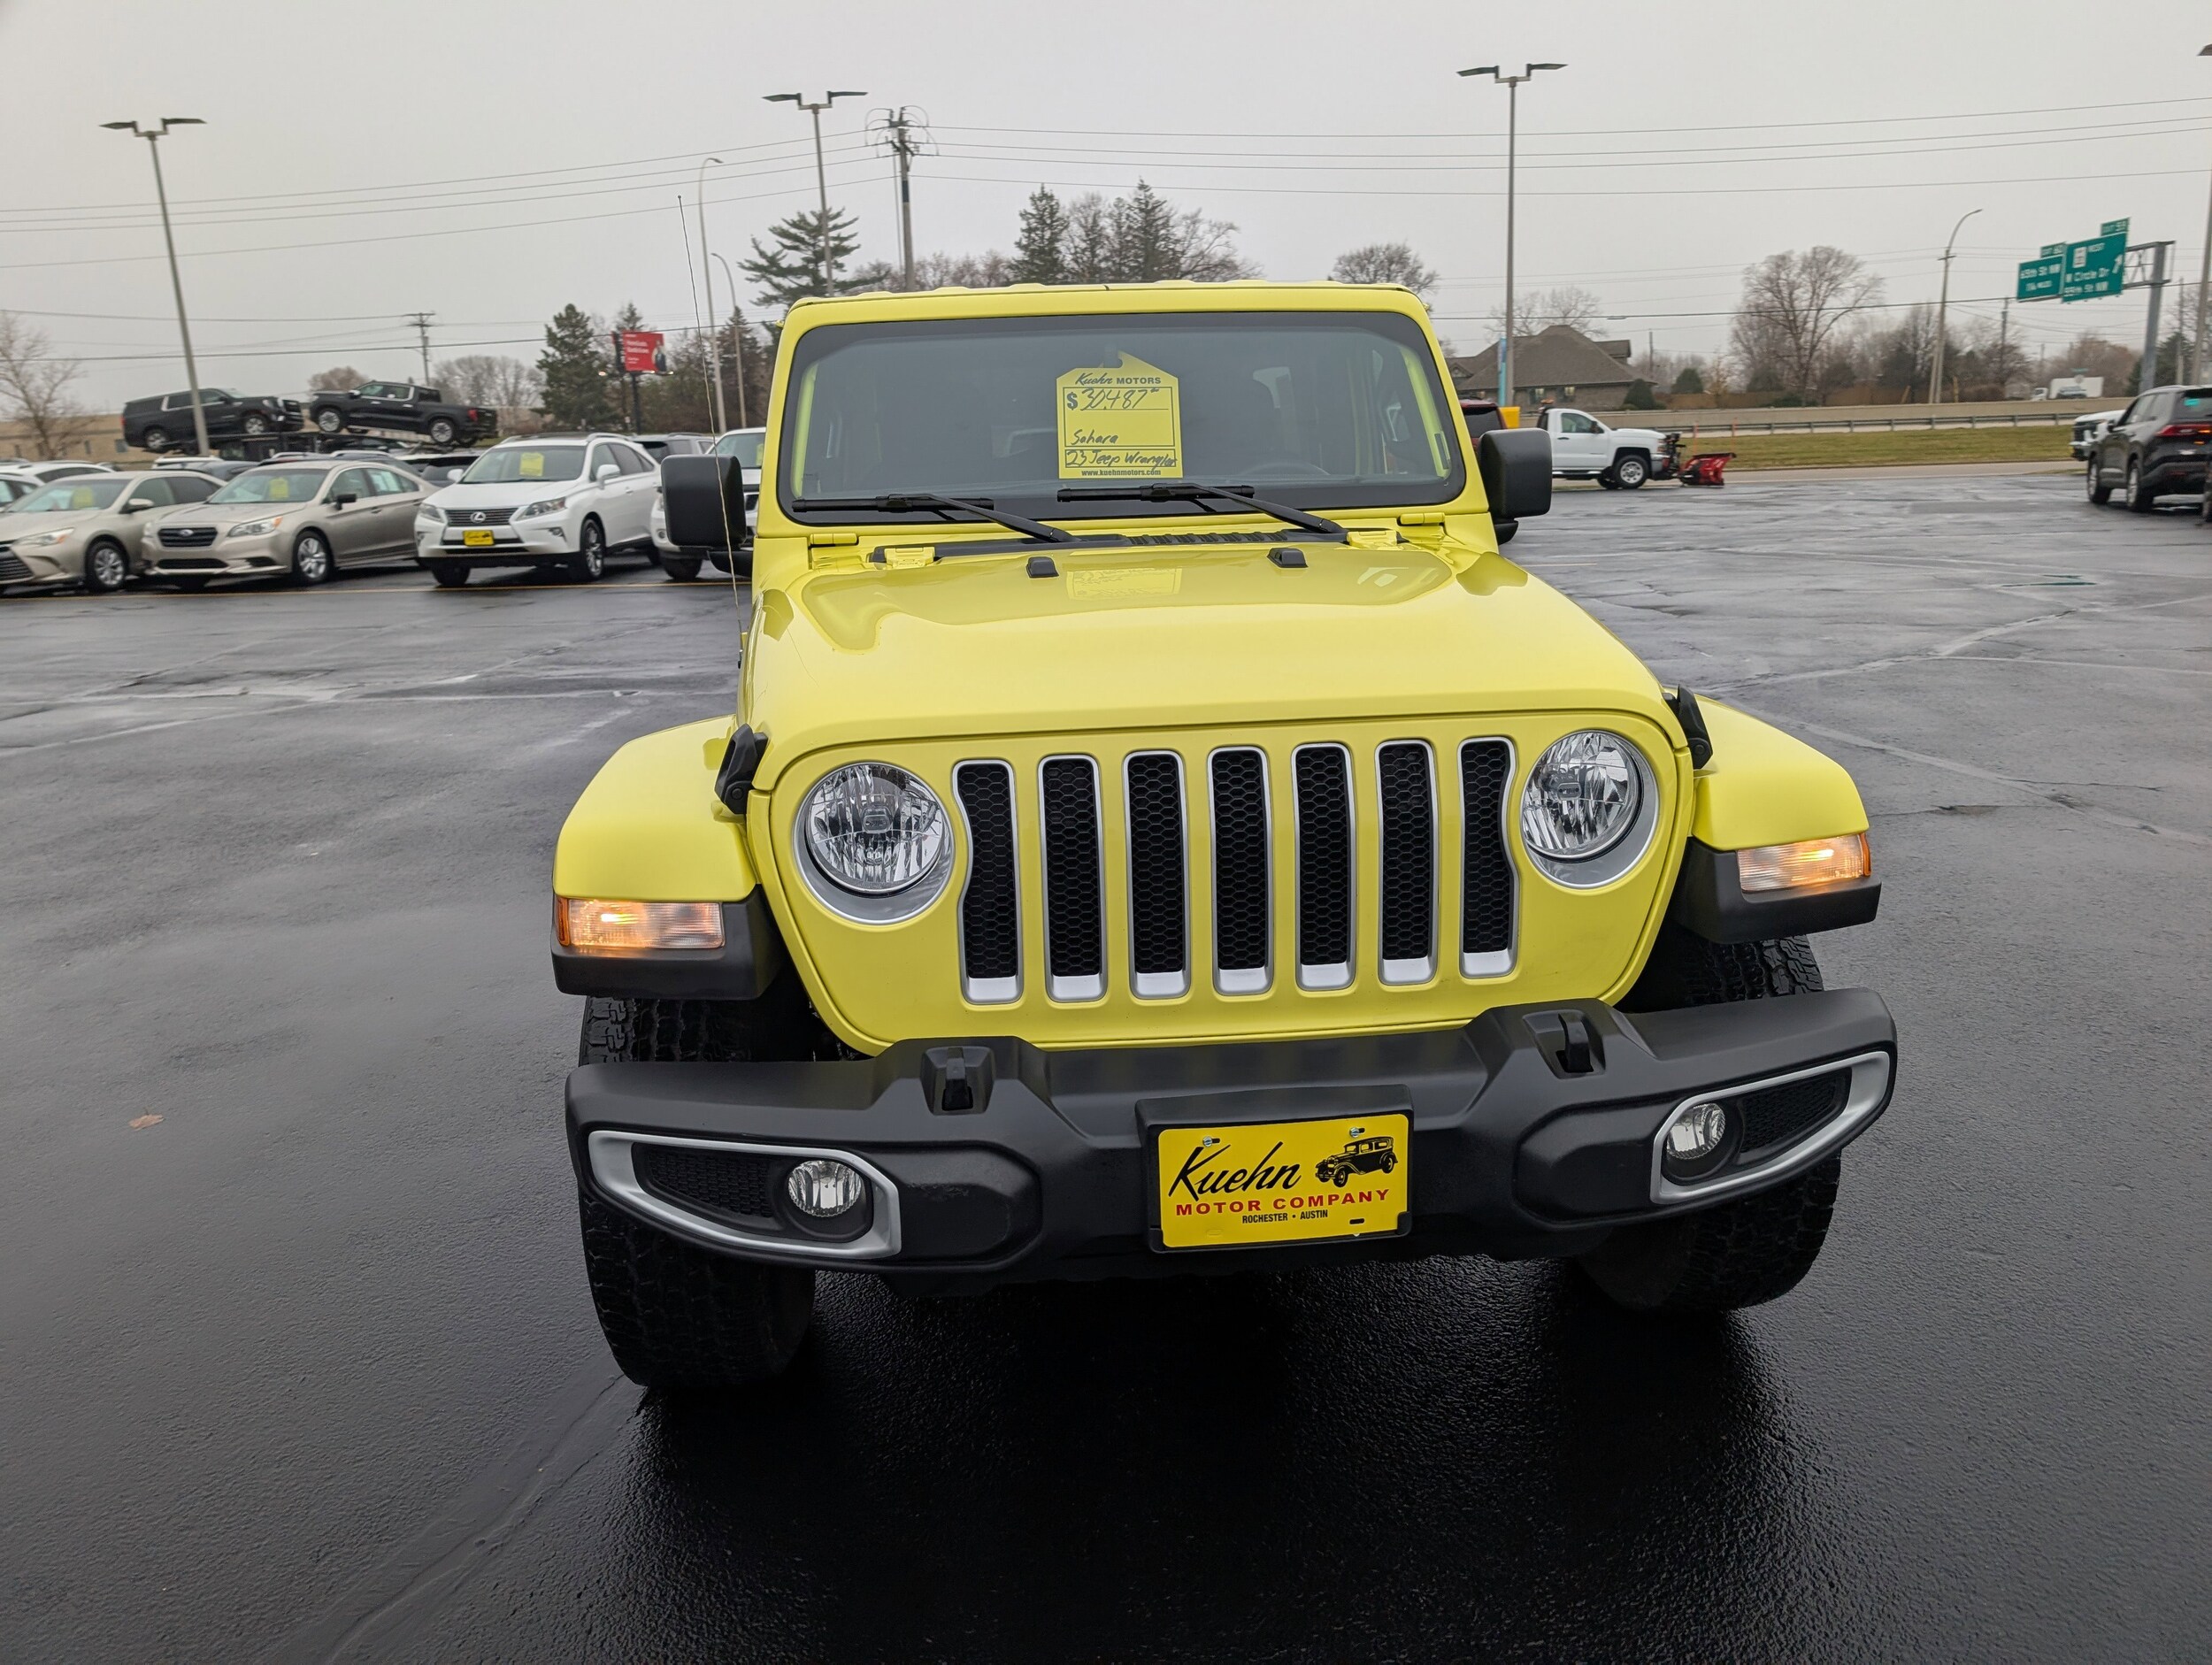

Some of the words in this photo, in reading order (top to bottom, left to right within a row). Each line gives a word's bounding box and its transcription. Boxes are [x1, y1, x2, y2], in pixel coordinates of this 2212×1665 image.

[1075, 372, 1113, 385] Kuehn
[1071, 429, 1119, 445] Sahara
[1066, 449, 1087, 467] 23
[1088, 449, 1121, 467] Jeep
[1168, 1141, 1302, 1201] Kuehn
[1176, 1200, 1261, 1216] MOTOR
[1272, 1188, 1389, 1209] COMPANY
[1241, 1212, 1288, 1224] ROCHESTER
[1300, 1208, 1328, 1220] AUSTIN
